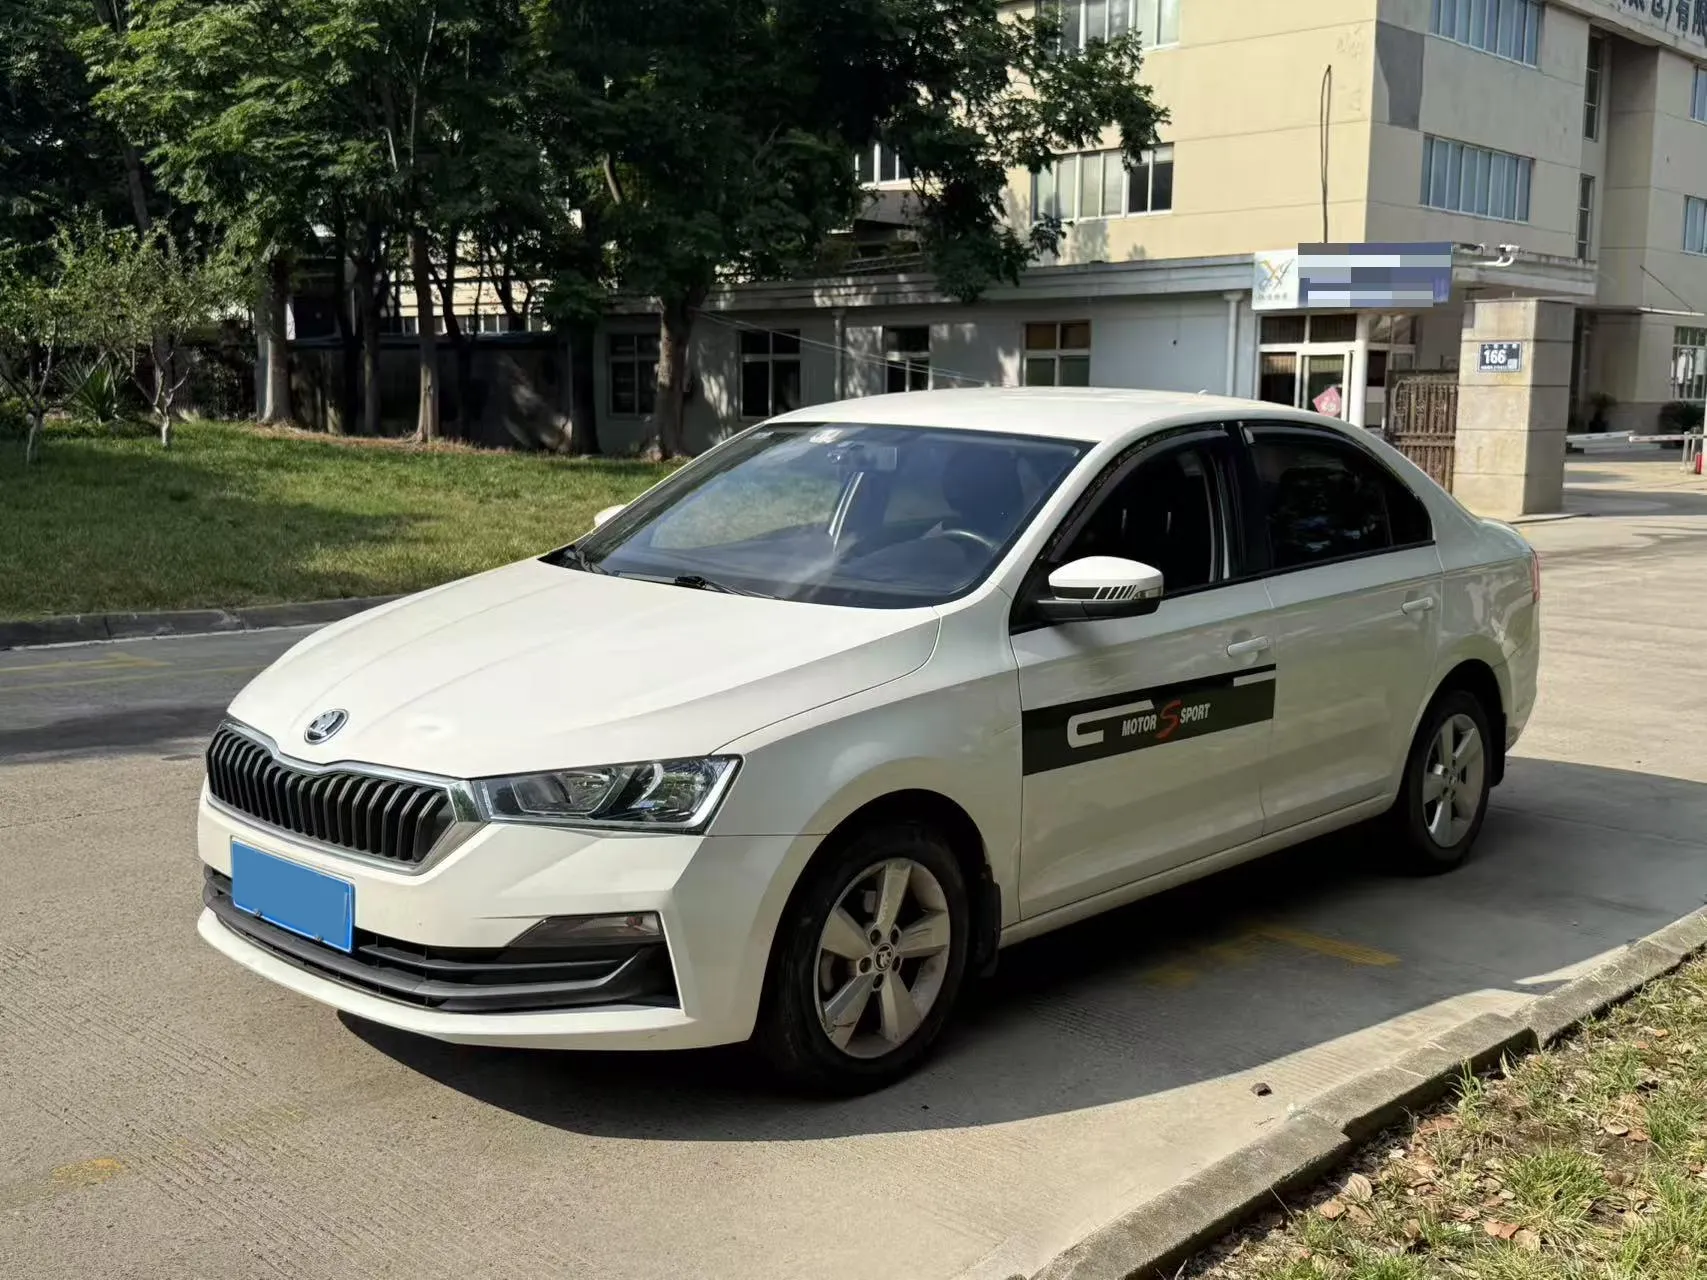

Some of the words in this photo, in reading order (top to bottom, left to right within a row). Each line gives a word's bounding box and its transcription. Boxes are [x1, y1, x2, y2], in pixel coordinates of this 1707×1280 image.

[1483, 349, 1507, 365] 166
[1121, 713, 1157, 737] MOTOR
[1180, 703, 1211, 724] SPORT
